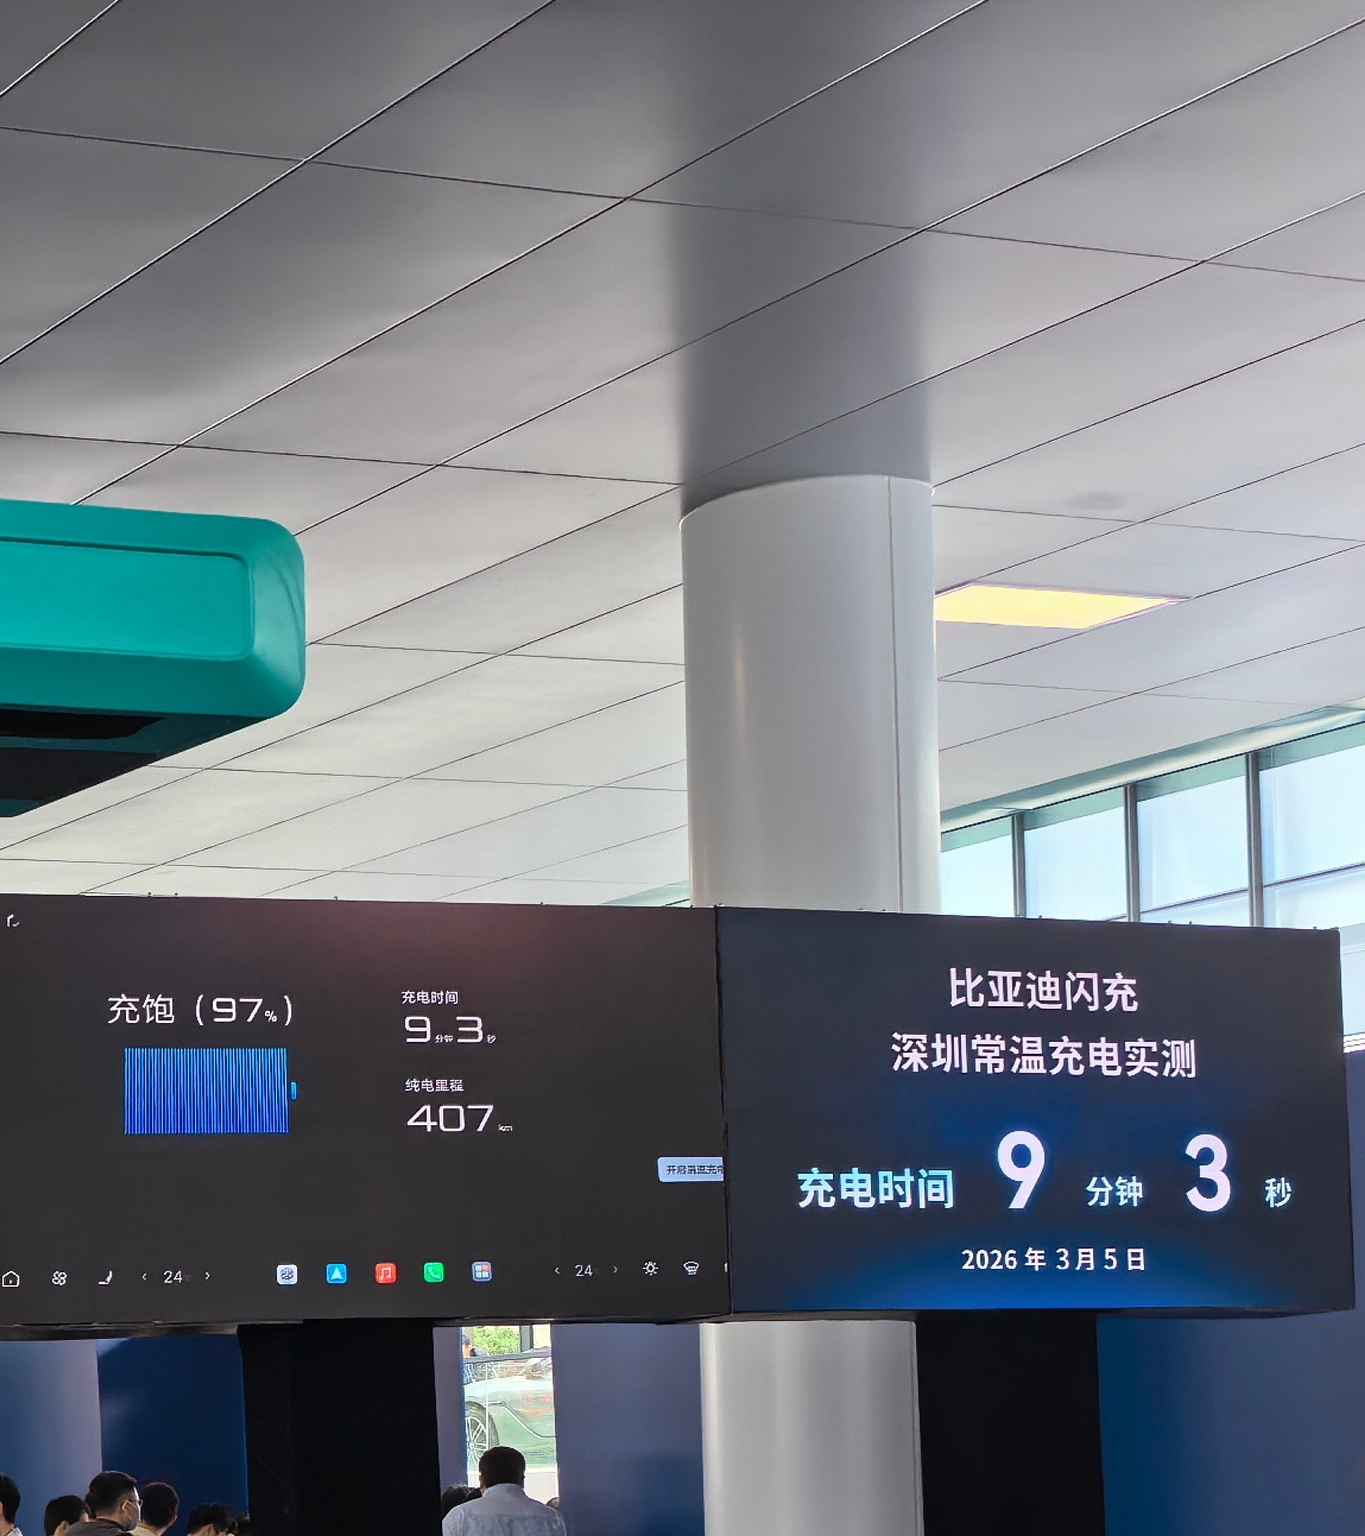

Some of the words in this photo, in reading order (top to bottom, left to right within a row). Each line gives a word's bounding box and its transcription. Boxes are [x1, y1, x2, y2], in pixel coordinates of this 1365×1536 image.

[401, 989, 459, 1006] 充电时间
[949, 967, 1139, 1012] 比亚迪闪充
[891, 1032, 1198, 1079] 深圳常温充电实测
[405, 1078, 464, 1093] 纯电里程
[407, 1103, 494, 1132] 407
[797, 1168, 954, 1209] 充电时间
[997, 1130, 1046, 1209] 9
[1086, 1175, 1144, 1207] 分钟
[1184, 1133, 1232, 1212] 3
[1264, 1176, 1293, 1208] 秒
